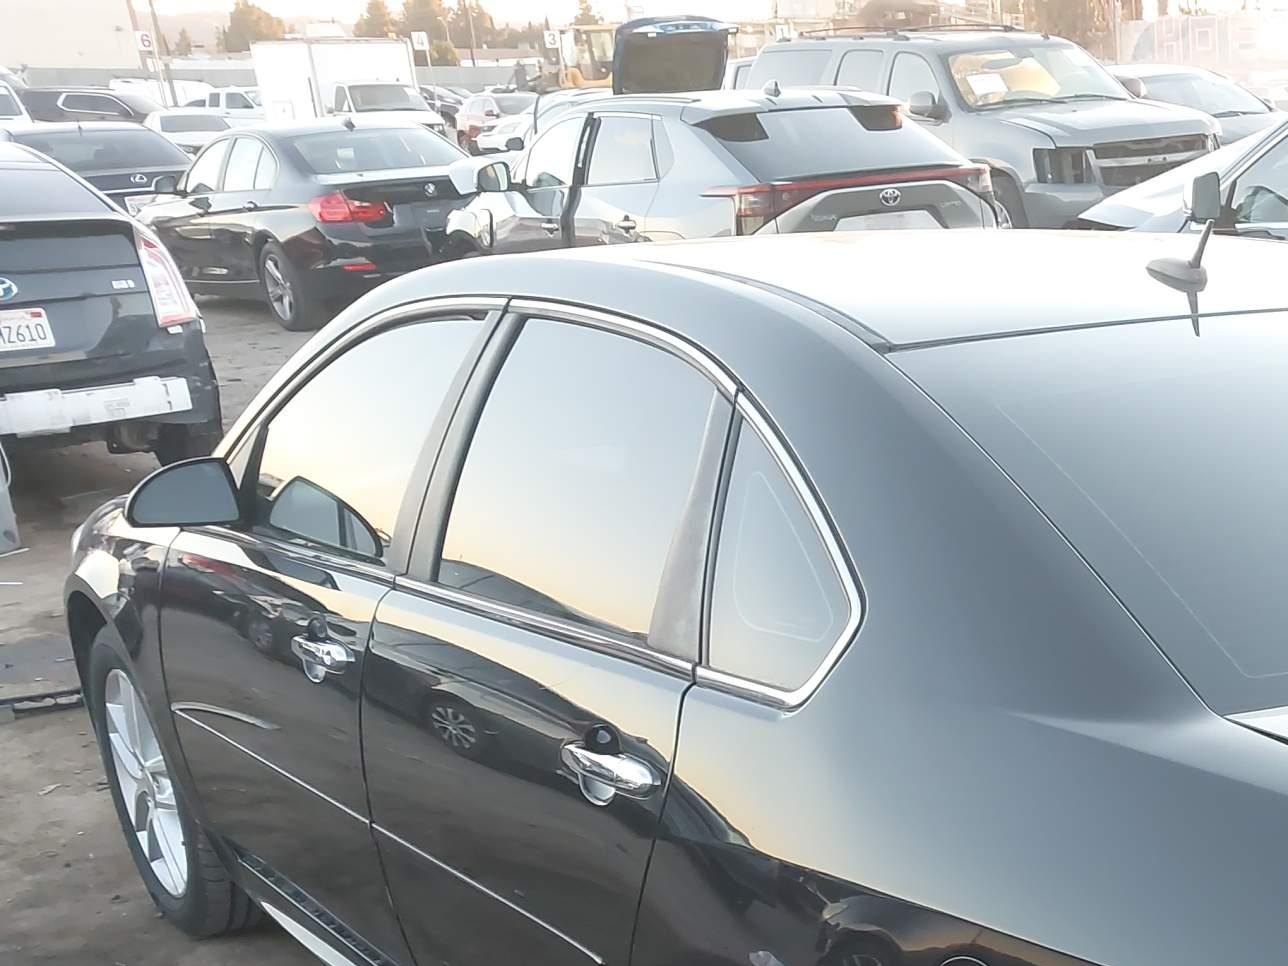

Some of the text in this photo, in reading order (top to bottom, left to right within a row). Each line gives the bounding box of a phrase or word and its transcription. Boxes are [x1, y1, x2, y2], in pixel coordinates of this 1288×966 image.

[140, 33, 152, 48] 6
[416, 34, 425, 48] 4
[548, 34, 557, 46] 3
